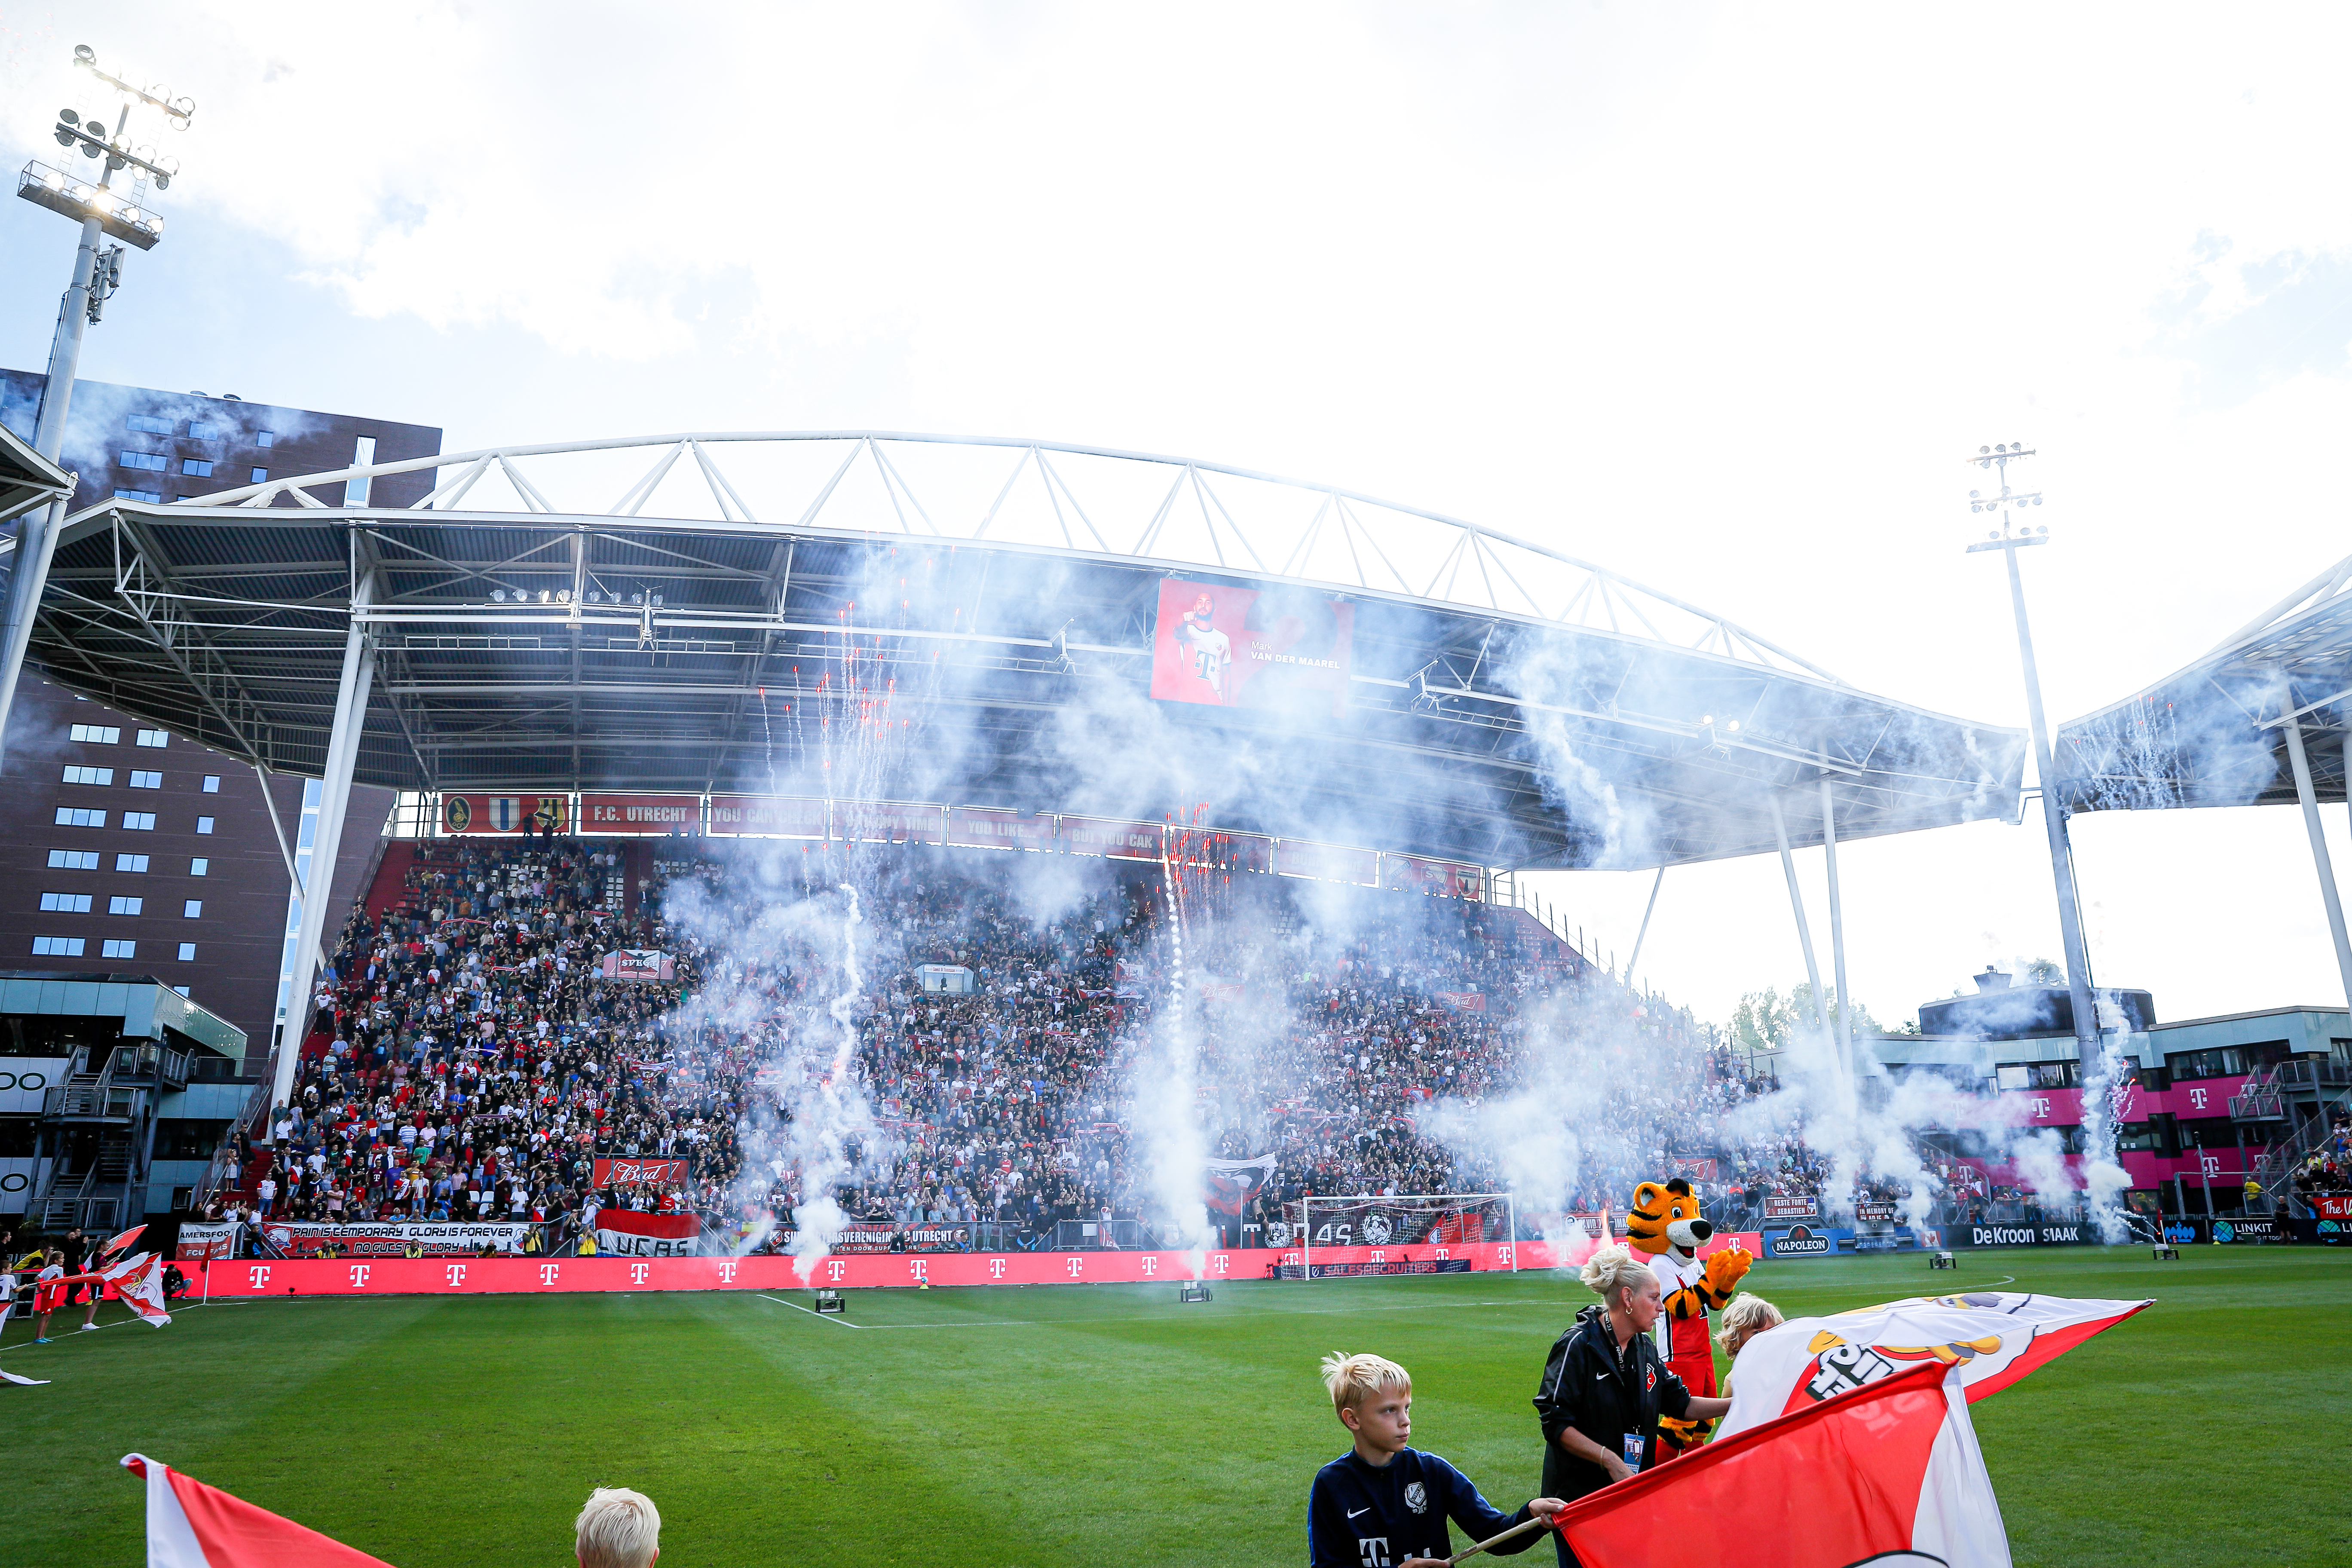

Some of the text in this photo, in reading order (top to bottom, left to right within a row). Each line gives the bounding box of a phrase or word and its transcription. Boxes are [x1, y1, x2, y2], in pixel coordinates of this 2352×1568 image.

[1251, 641, 1272, 651] Mark
[1250, 651, 1341, 670] VAN DER MAAREL
[594, 805, 687, 822] F.C. UTRECHT
[714, 807, 741, 823] YOU
[747, 808, 771, 823] CAN
[906, 816, 934, 832] TIME
[967, 820, 1036, 838] YOU LIKE...
[1072, 828, 1153, 848] BUT YOU CAN
[617, 1163, 662, 1181] Bud
[2322, 1200, 2343, 1214] The
[291, 1226, 513, 1237] PAIN IS TEMPORARY GLORY IS FOREVER
[2235, 1223, 2272, 1232] LINKIT
[597, 1232, 688, 1256] LUCAS
[912, 1230, 952, 1242] UTRECHT
[353, 1242, 371, 1253] NO
[371, 1242, 404, 1253] GUTS
[423, 1242, 460, 1253] GLORY
[1776, 1240, 1825, 1251] NAPOLEON
[1616, 1346, 1624, 1364] Utrecht
